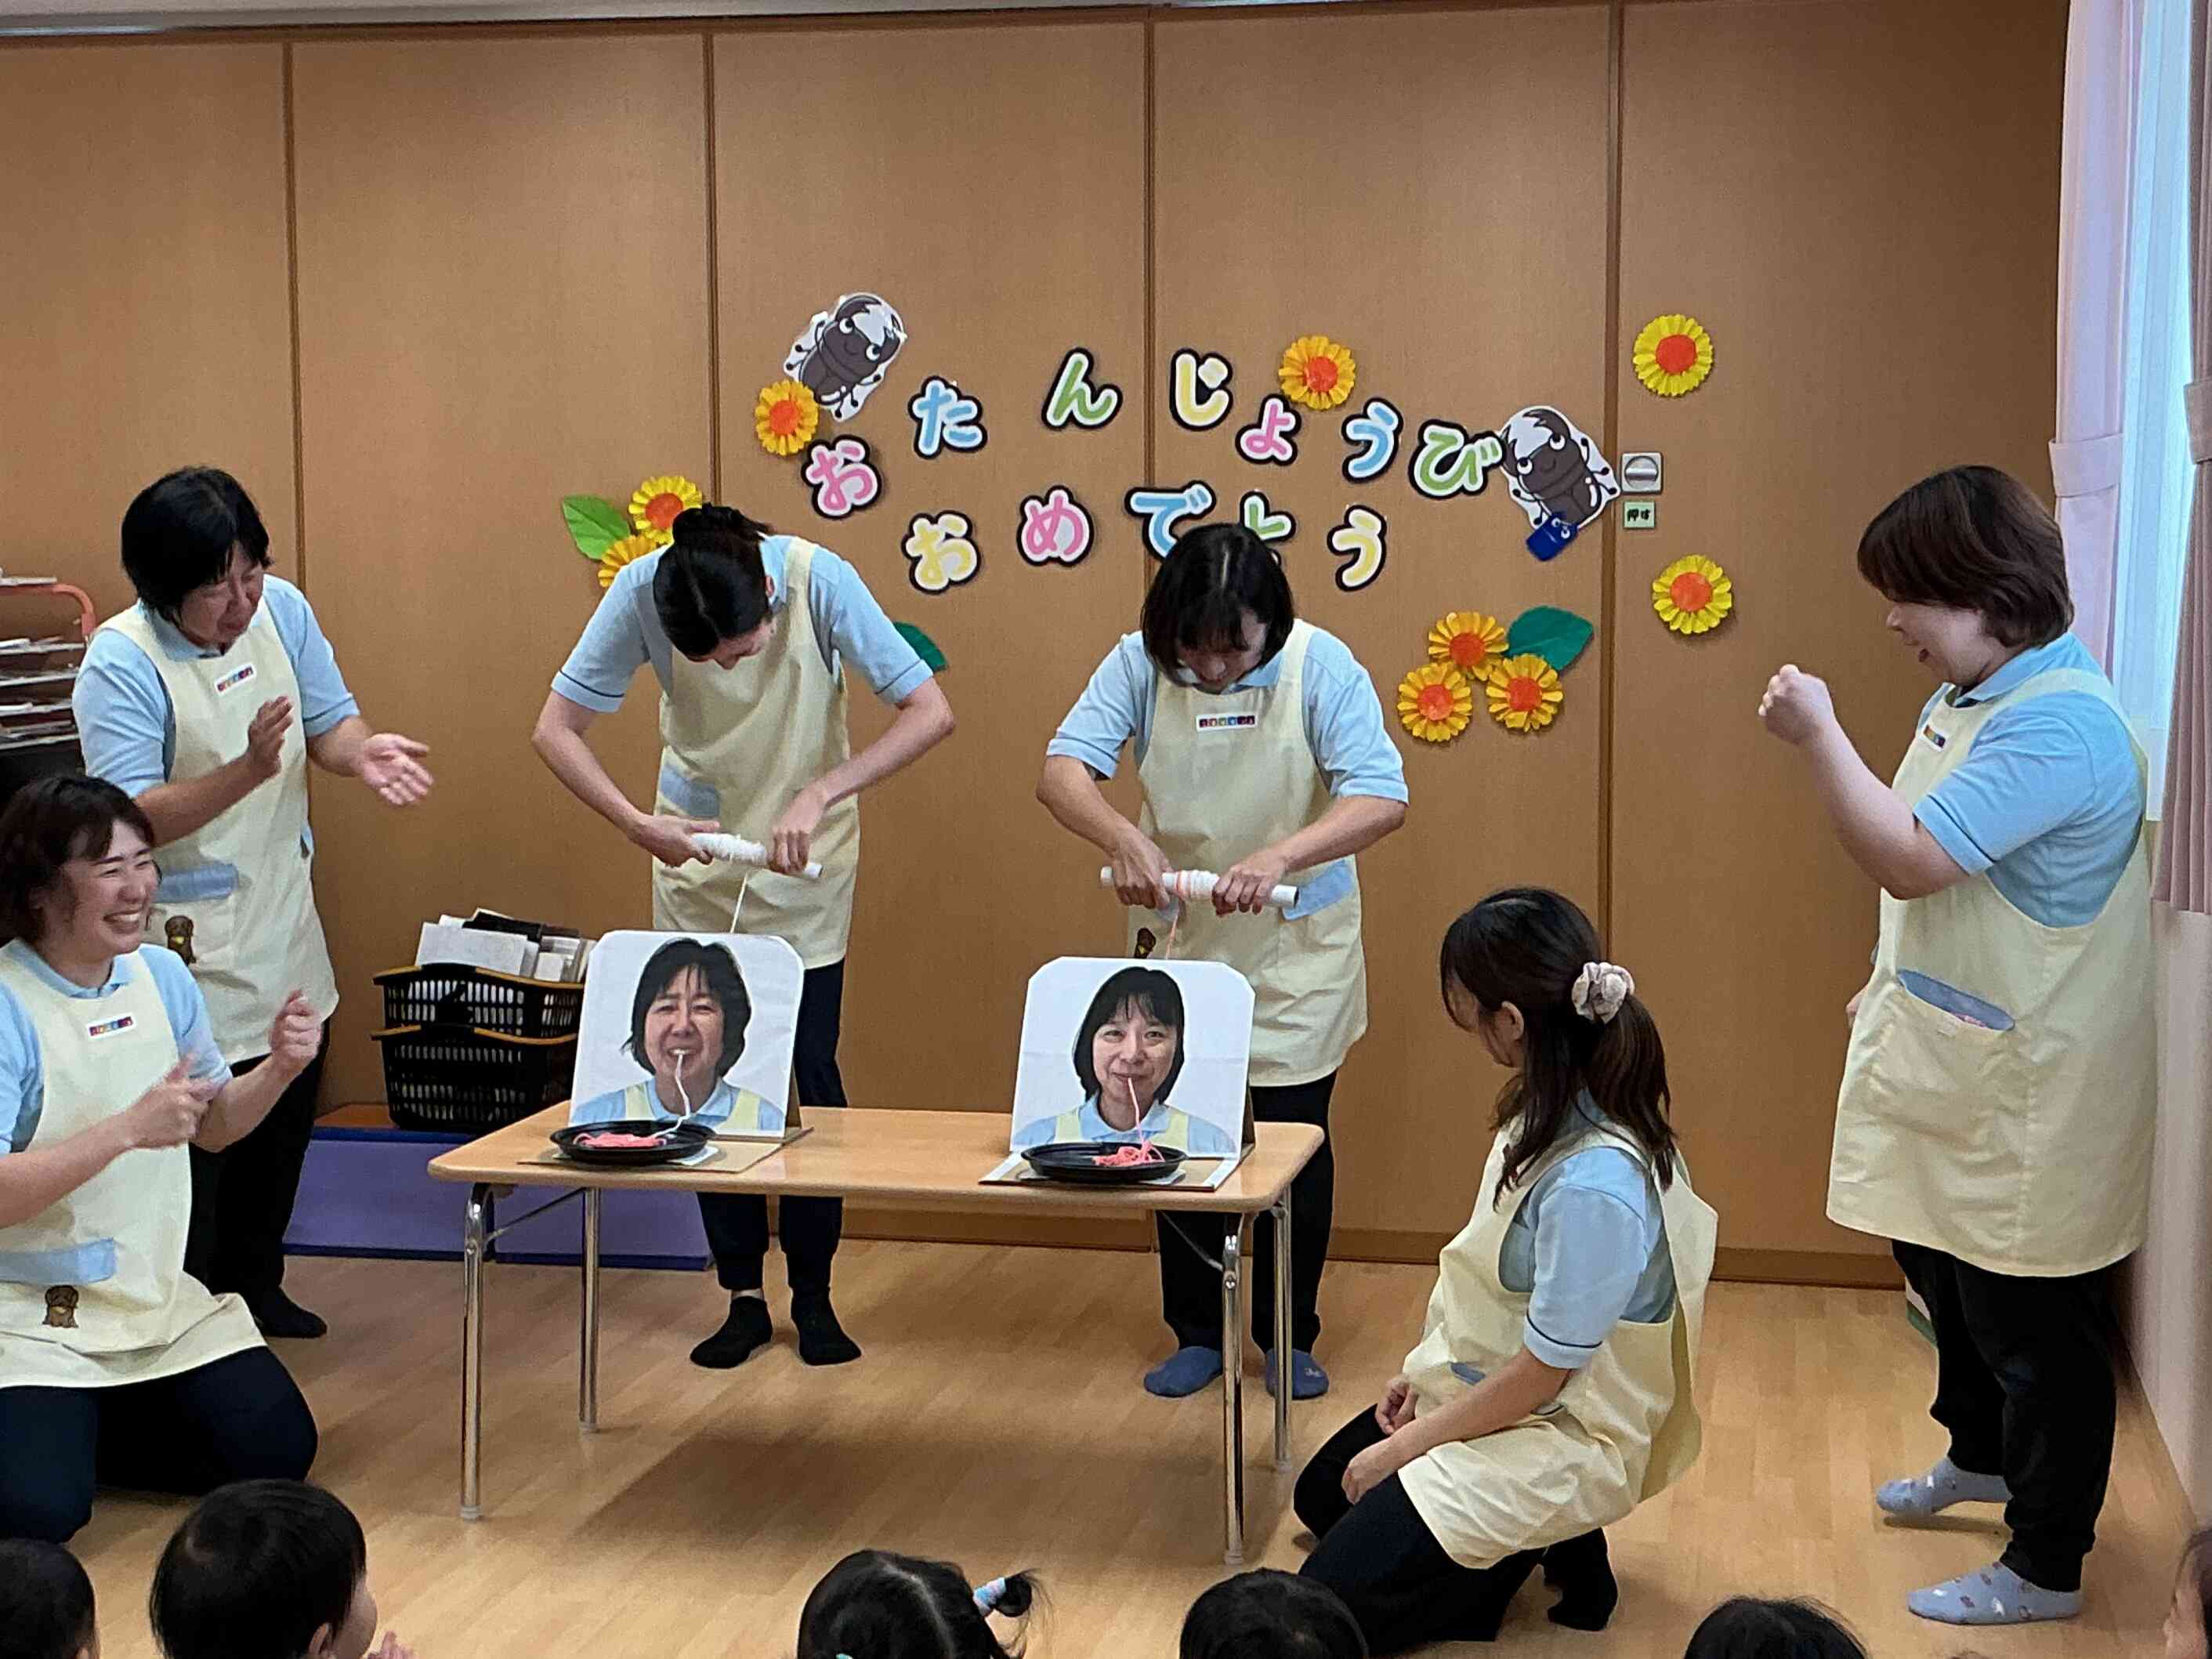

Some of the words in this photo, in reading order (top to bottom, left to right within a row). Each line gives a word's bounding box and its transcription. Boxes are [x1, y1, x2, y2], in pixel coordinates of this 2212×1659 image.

[803, 349, 1504, 518] おたんじょうび
